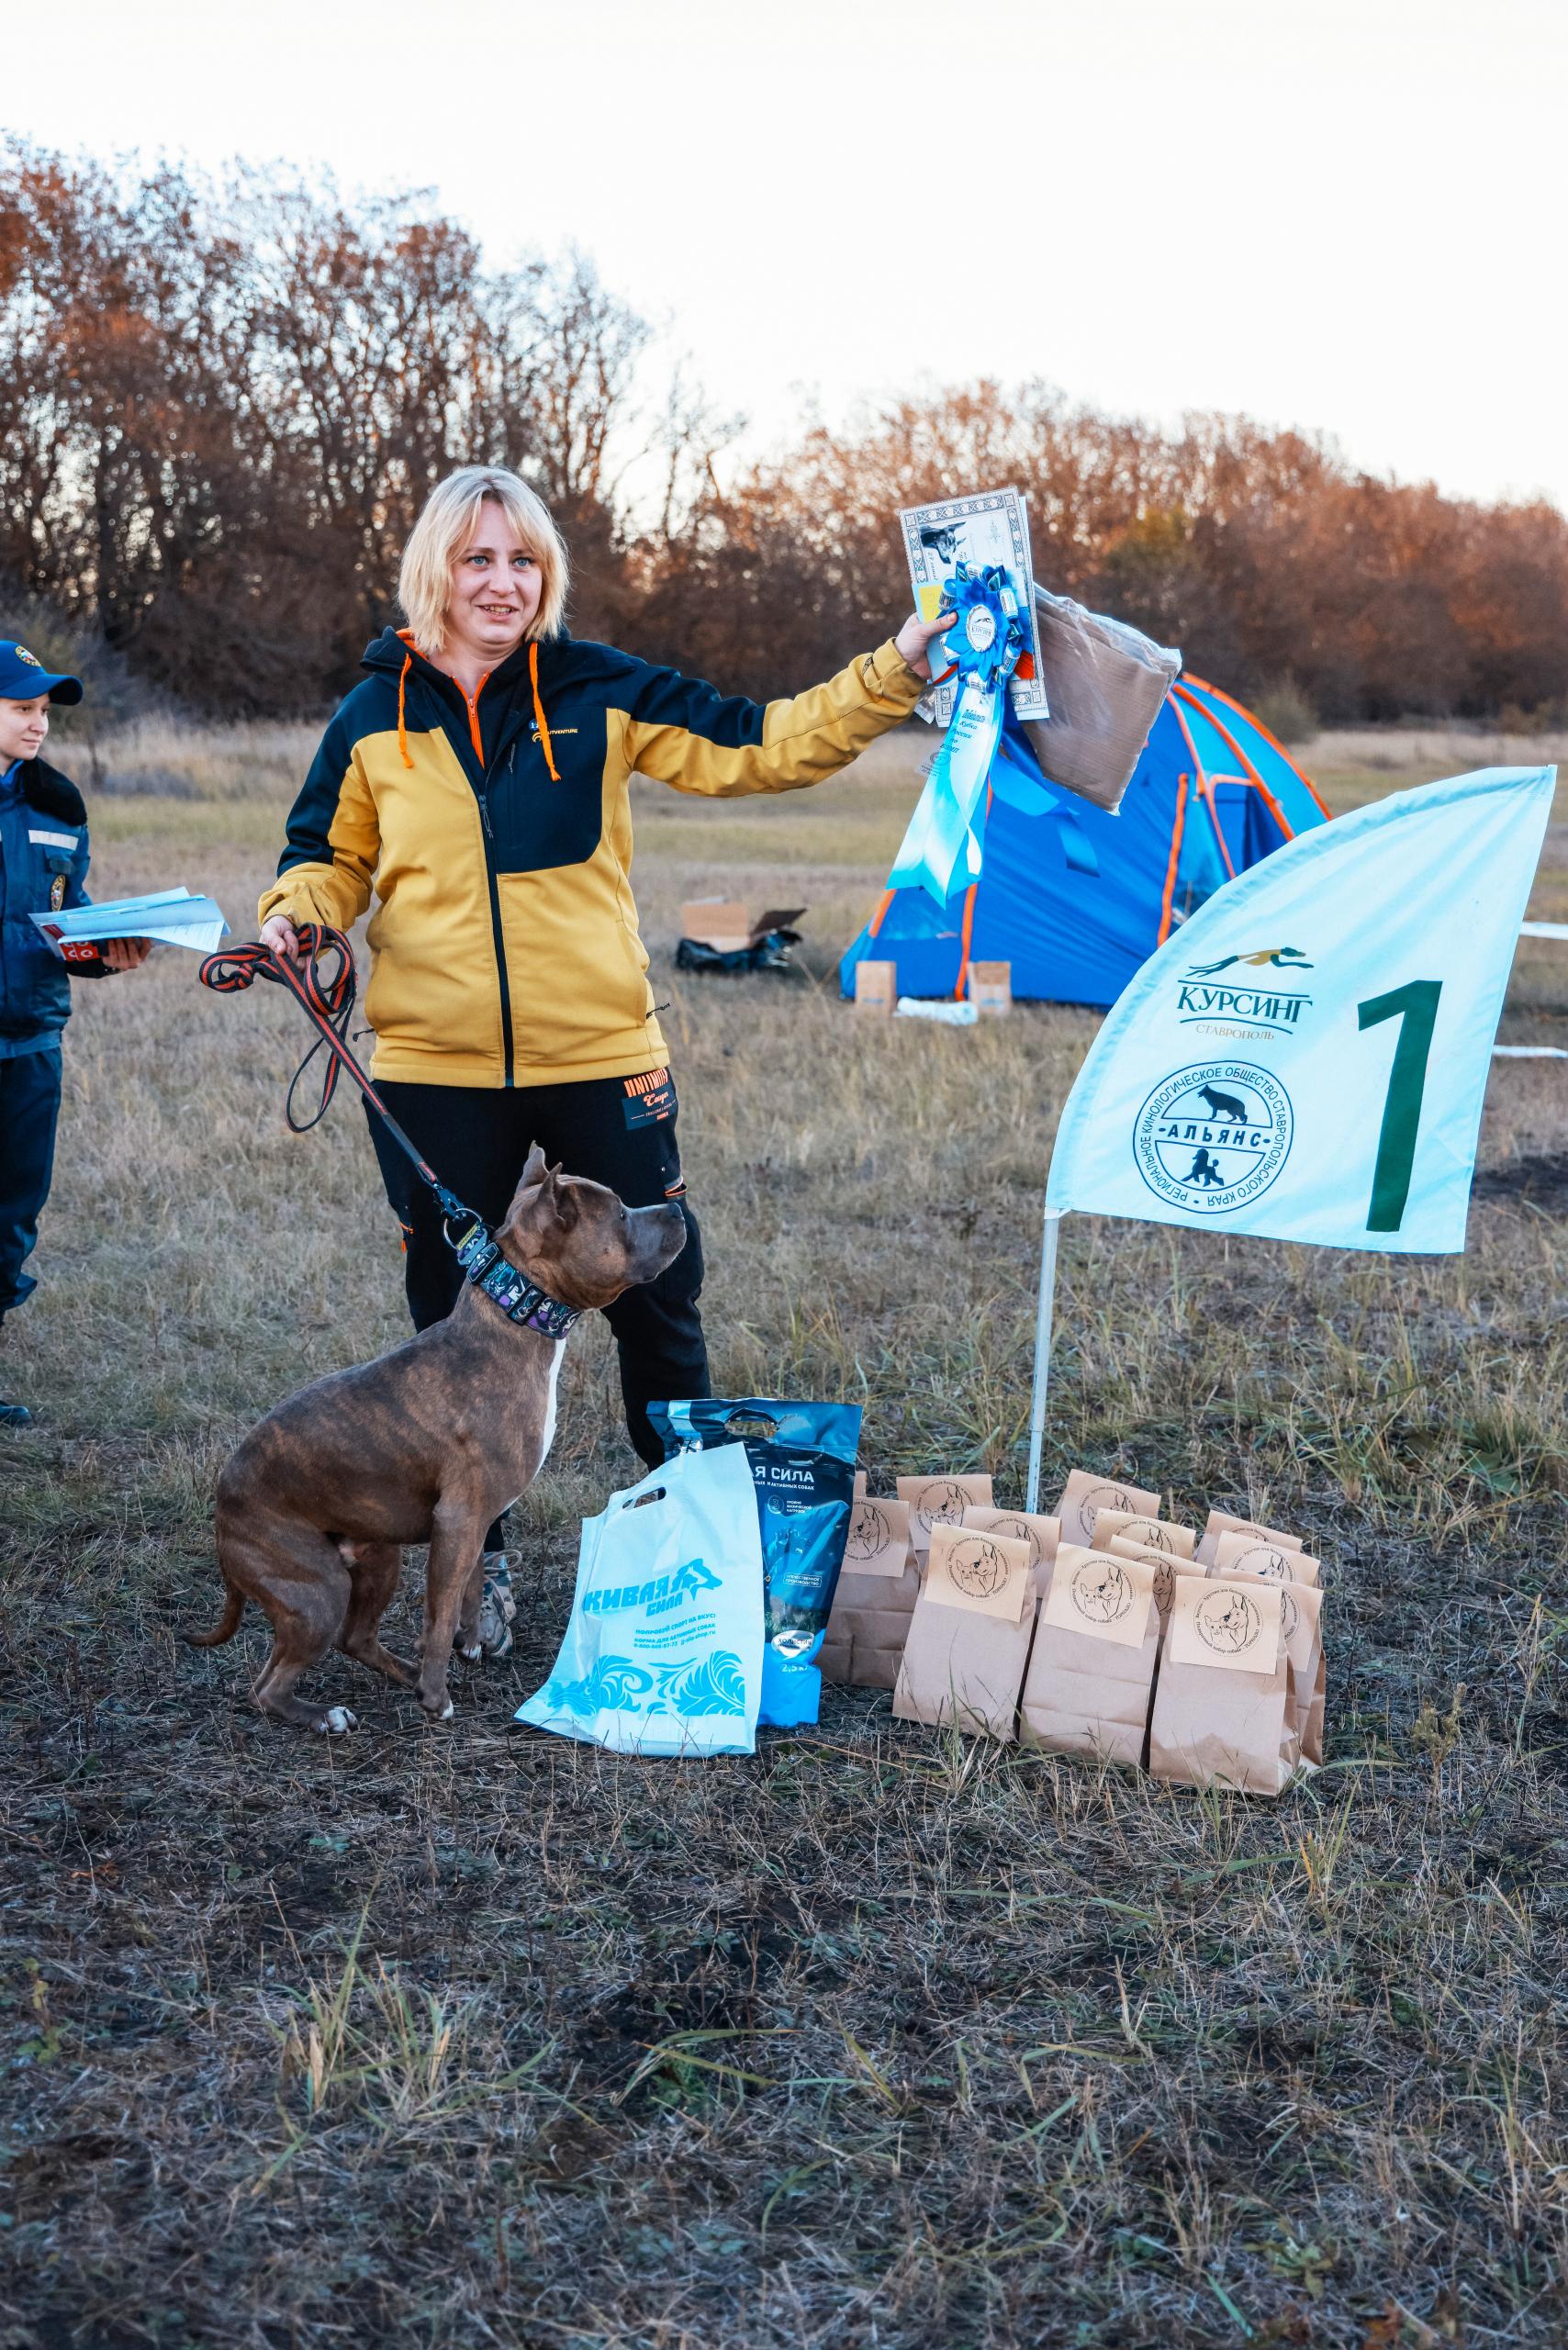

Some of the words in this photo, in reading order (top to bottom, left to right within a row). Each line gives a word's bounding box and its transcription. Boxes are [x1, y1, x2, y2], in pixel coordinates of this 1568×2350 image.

[1177, 986, 1313, 1023] КУРСИНГ
[1195, 1024, 1274, 1040] СТАВРОПОЛЬ
[1225, 1067, 1279, 1101] ОБЩЕСТВО
[1142, 1068, 1222, 1134] КИНОЛОГИЧЕСКОЕ
[1358, 979, 1443, 1233] 1
[1167, 1125, 1261, 1147] АЛЬЯНС
[1238, 1101, 1287, 1199] СТАВРОПОЛЬСКОГО
[1140, 1136, 1189, 1202] РЕГИОНАЛЬНОЕ
[1207, 1192, 1236, 1206] КРАЯ
[771, 1467, 814, 1483] СИЛА
[876, 1538, 890, 1555] ТОРНАДО
[956, 1538, 971, 1546] Хрустно
[1072, 1571, 1081, 1585] Вкусно
[1081, 1560, 1097, 1569] Хрустно
[992, 1577, 1007, 1595] ТОРНАДО
[1203, 1590, 1220, 1601] Хрустно
[645, 1592, 683, 1617] СИЛА
[1115, 1603, 1131, 1619] ТОРНАДО
[635, 1625, 670, 1635] ПОПРОБУЙ
[671, 1619, 688, 1630] СПОРТ
[670, 1628, 697, 1640] АКТИВНЫХ
[697, 1623, 716, 1631] СОБАК
[1245, 1628, 1260, 1649] ТОРНАДО
